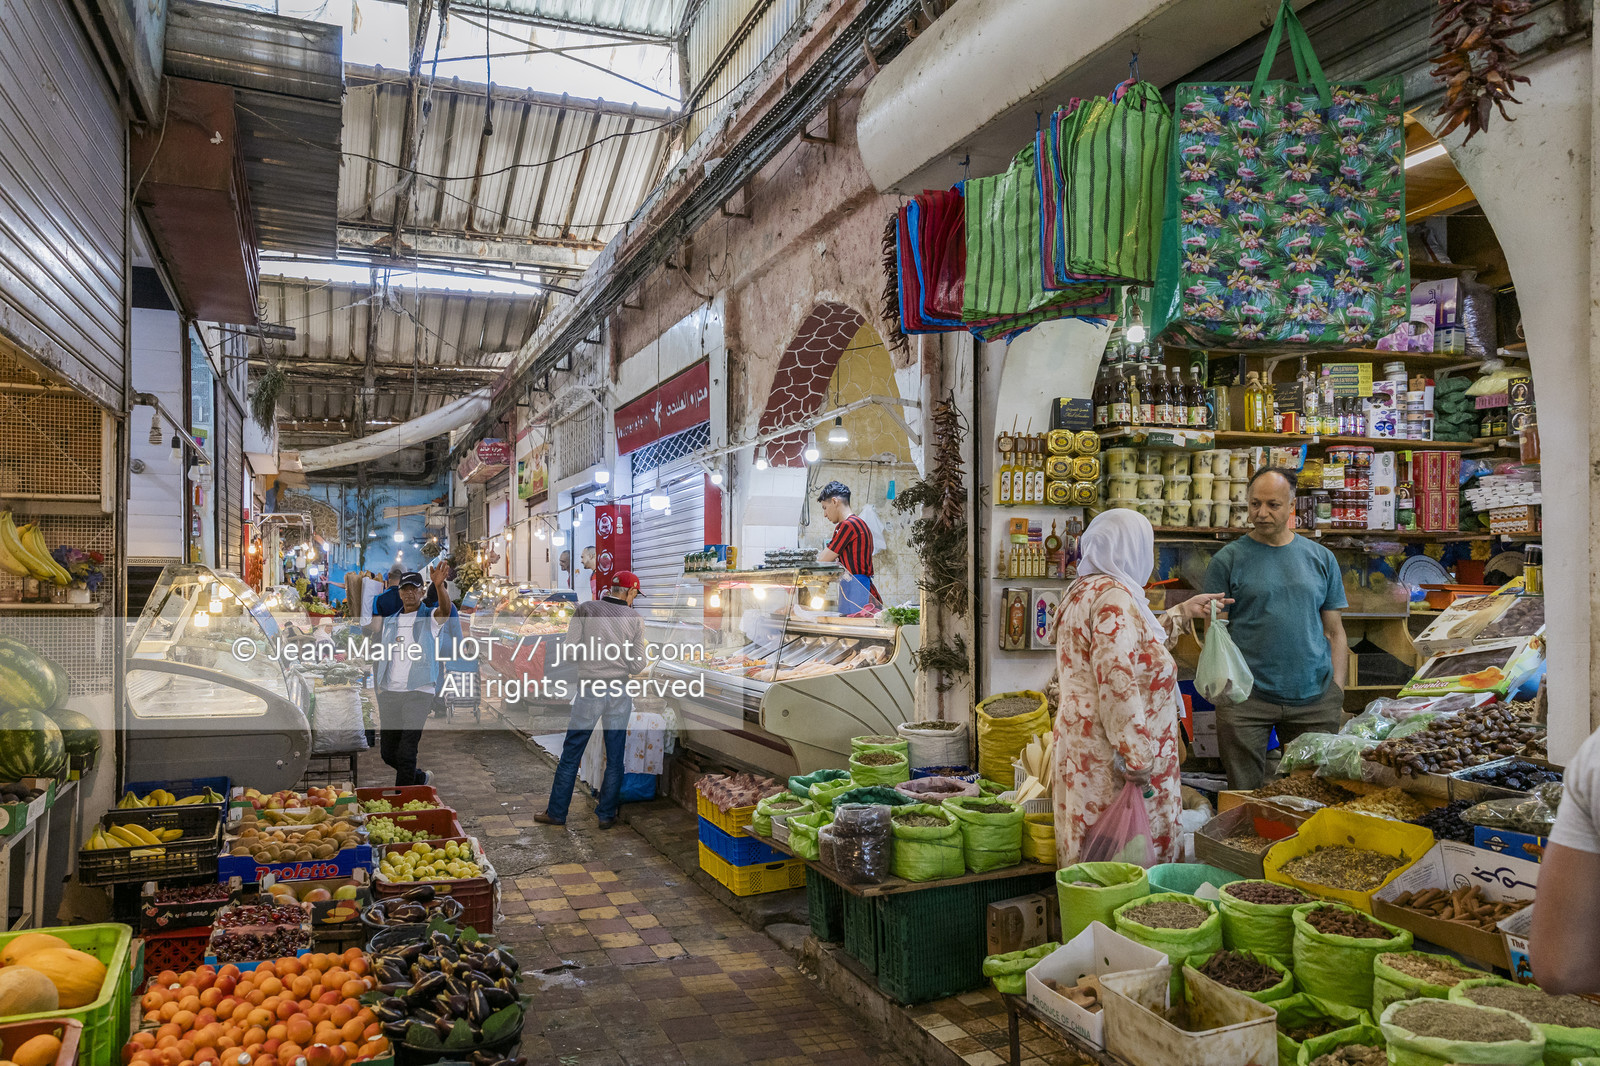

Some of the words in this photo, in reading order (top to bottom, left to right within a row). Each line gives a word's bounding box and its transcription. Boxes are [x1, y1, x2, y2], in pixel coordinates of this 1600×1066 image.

[1032, 994, 1060, 1020] PRODUCE
[1060, 1014, 1069, 1024] OF
[1071, 1020, 1091, 1040] CHINA
